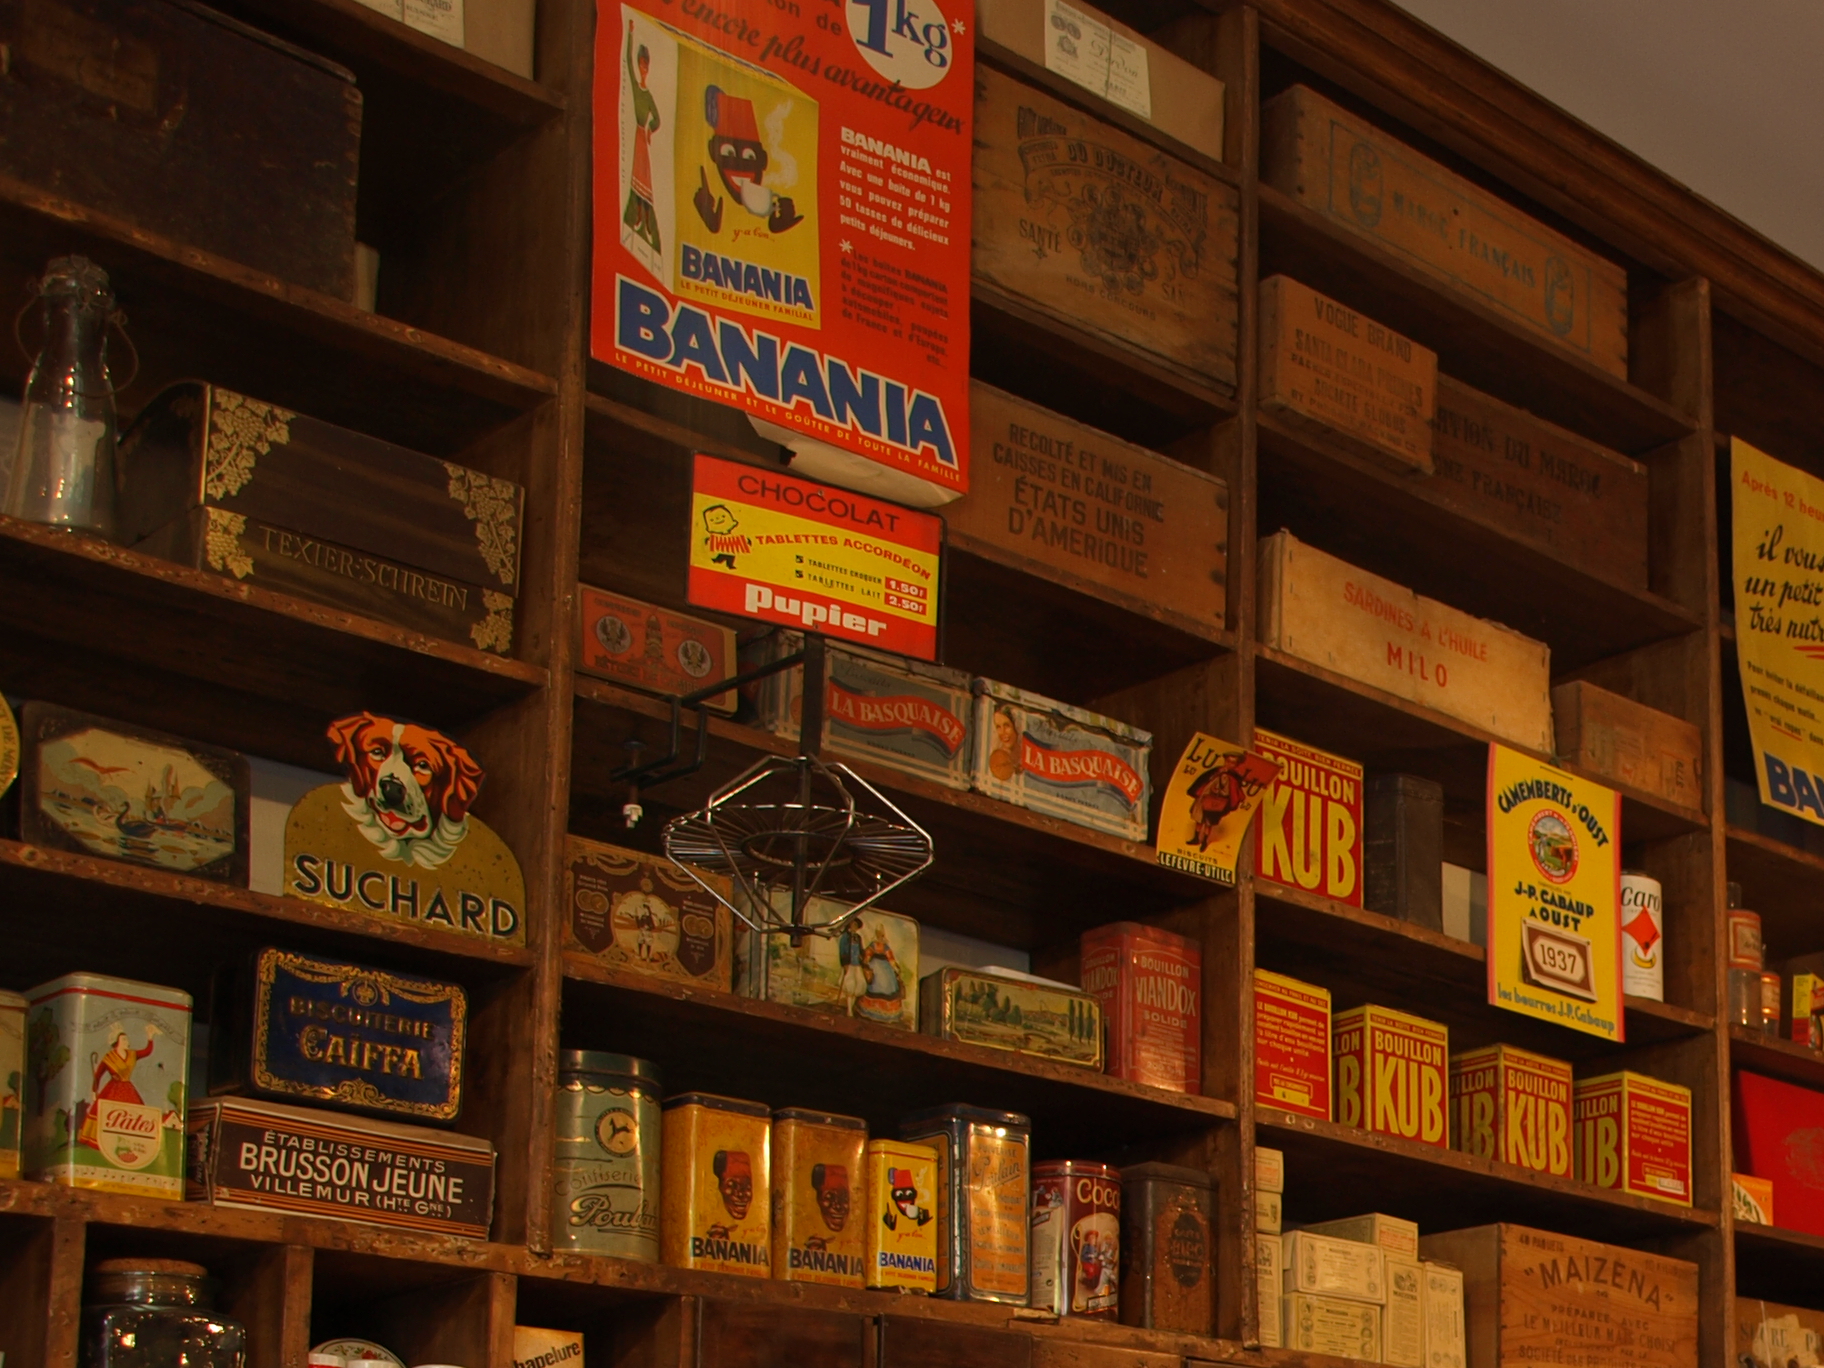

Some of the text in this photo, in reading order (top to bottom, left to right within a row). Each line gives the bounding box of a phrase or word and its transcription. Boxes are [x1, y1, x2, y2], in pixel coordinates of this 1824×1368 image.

[760, 35, 822, 76] plus
[824, 64, 964, 135] avantageux
[840, 126, 931, 174] BANANIA
[840, 145, 884, 169] vraiment
[840, 160, 862, 179] Avec
[839, 179, 949, 228] vous pouvez préparer
[856, 202, 949, 245] tasses délicieux
[869, 223, 916, 250] déjeuners.
[681, 244, 815, 312] BANANIA
[694, 283, 814, 322] PETIT DÉJEUNER FAMILIAL
[1314, 297, 1412, 363] VOGUE BRAND
[615, 273, 959, 470] BANANIA
[615, 352, 961, 483] LE PETIT DÉJEUNER GOÛTER DE TOUTE LA FAMILLE
[993, 442, 1165, 523] CAISSES EN CALIFORNIE
[1079, 449, 1152, 493] ET MIS EN
[1742, 470, 1778, 501] Après
[1784, 490, 1795, 508] 12
[737, 475, 900, 533] CHOCOLAT
[1014, 475, 1144, 546] ÉTATS UNIS
[755, 534, 931, 580] TABLETTES ACCORDÉON
[1757, 524, 1784, 562] il
[808, 559, 882, 585] TABLETTES CROQUER
[808, 572, 881, 600] TABLETTES LAIT
[1745, 576, 1777, 599] un
[1778, 578, 1823, 608] petit
[1344, 580, 1488, 664] SARDINES L'HUILE
[1749, 602, 1782, 635] très
[1387, 642, 1448, 689] MILO
[831, 690, 962, 745] LA BASQUAISE
[1023, 746, 1141, 795] LA BASQUAISE
[1187, 738, 1222, 768] LU
[1499, 777, 1573, 814] CAMEMBERTS
[1262, 782, 1356, 898] KUB
[292, 853, 521, 939] SUCHARD
[1540, 888, 1594, 918] CABAUP
[1539, 909, 1581, 931] OUST
[1141, 955, 1189, 979] BOUILLON
[1539, 944, 1577, 974] 1937
[1135, 975, 1197, 1017] VIANDOX
[289, 996, 435, 1040] BISCUITERIE
[1143, 1010, 1188, 1029] SOLIDE
[301, 1023, 423, 1080] CAÏFFA
[1375, 1029, 1442, 1067] BOUILLON
[1375, 1051, 1444, 1143] KUB
[1508, 1068, 1567, 1103] BOUILLON
[264, 1129, 446, 1172] ÉTABLISSEMENTS
[1507, 1090, 1568, 1176] KUB
[239, 1142, 464, 1204] BRUSSON JEUNE
[250, 1174, 370, 1206] VILLEMUR
[555, 1167, 642, 1197] Confiserie
[690, 1236, 771, 1268] BANANIA
[788, 1247, 866, 1278] BANANIA
[878, 1250, 936, 1273] BANANIA
[1524, 1313, 1677, 1354] LE MEILLEUR CHOISI
[1621, 1318, 1649, 1331] AVEC
